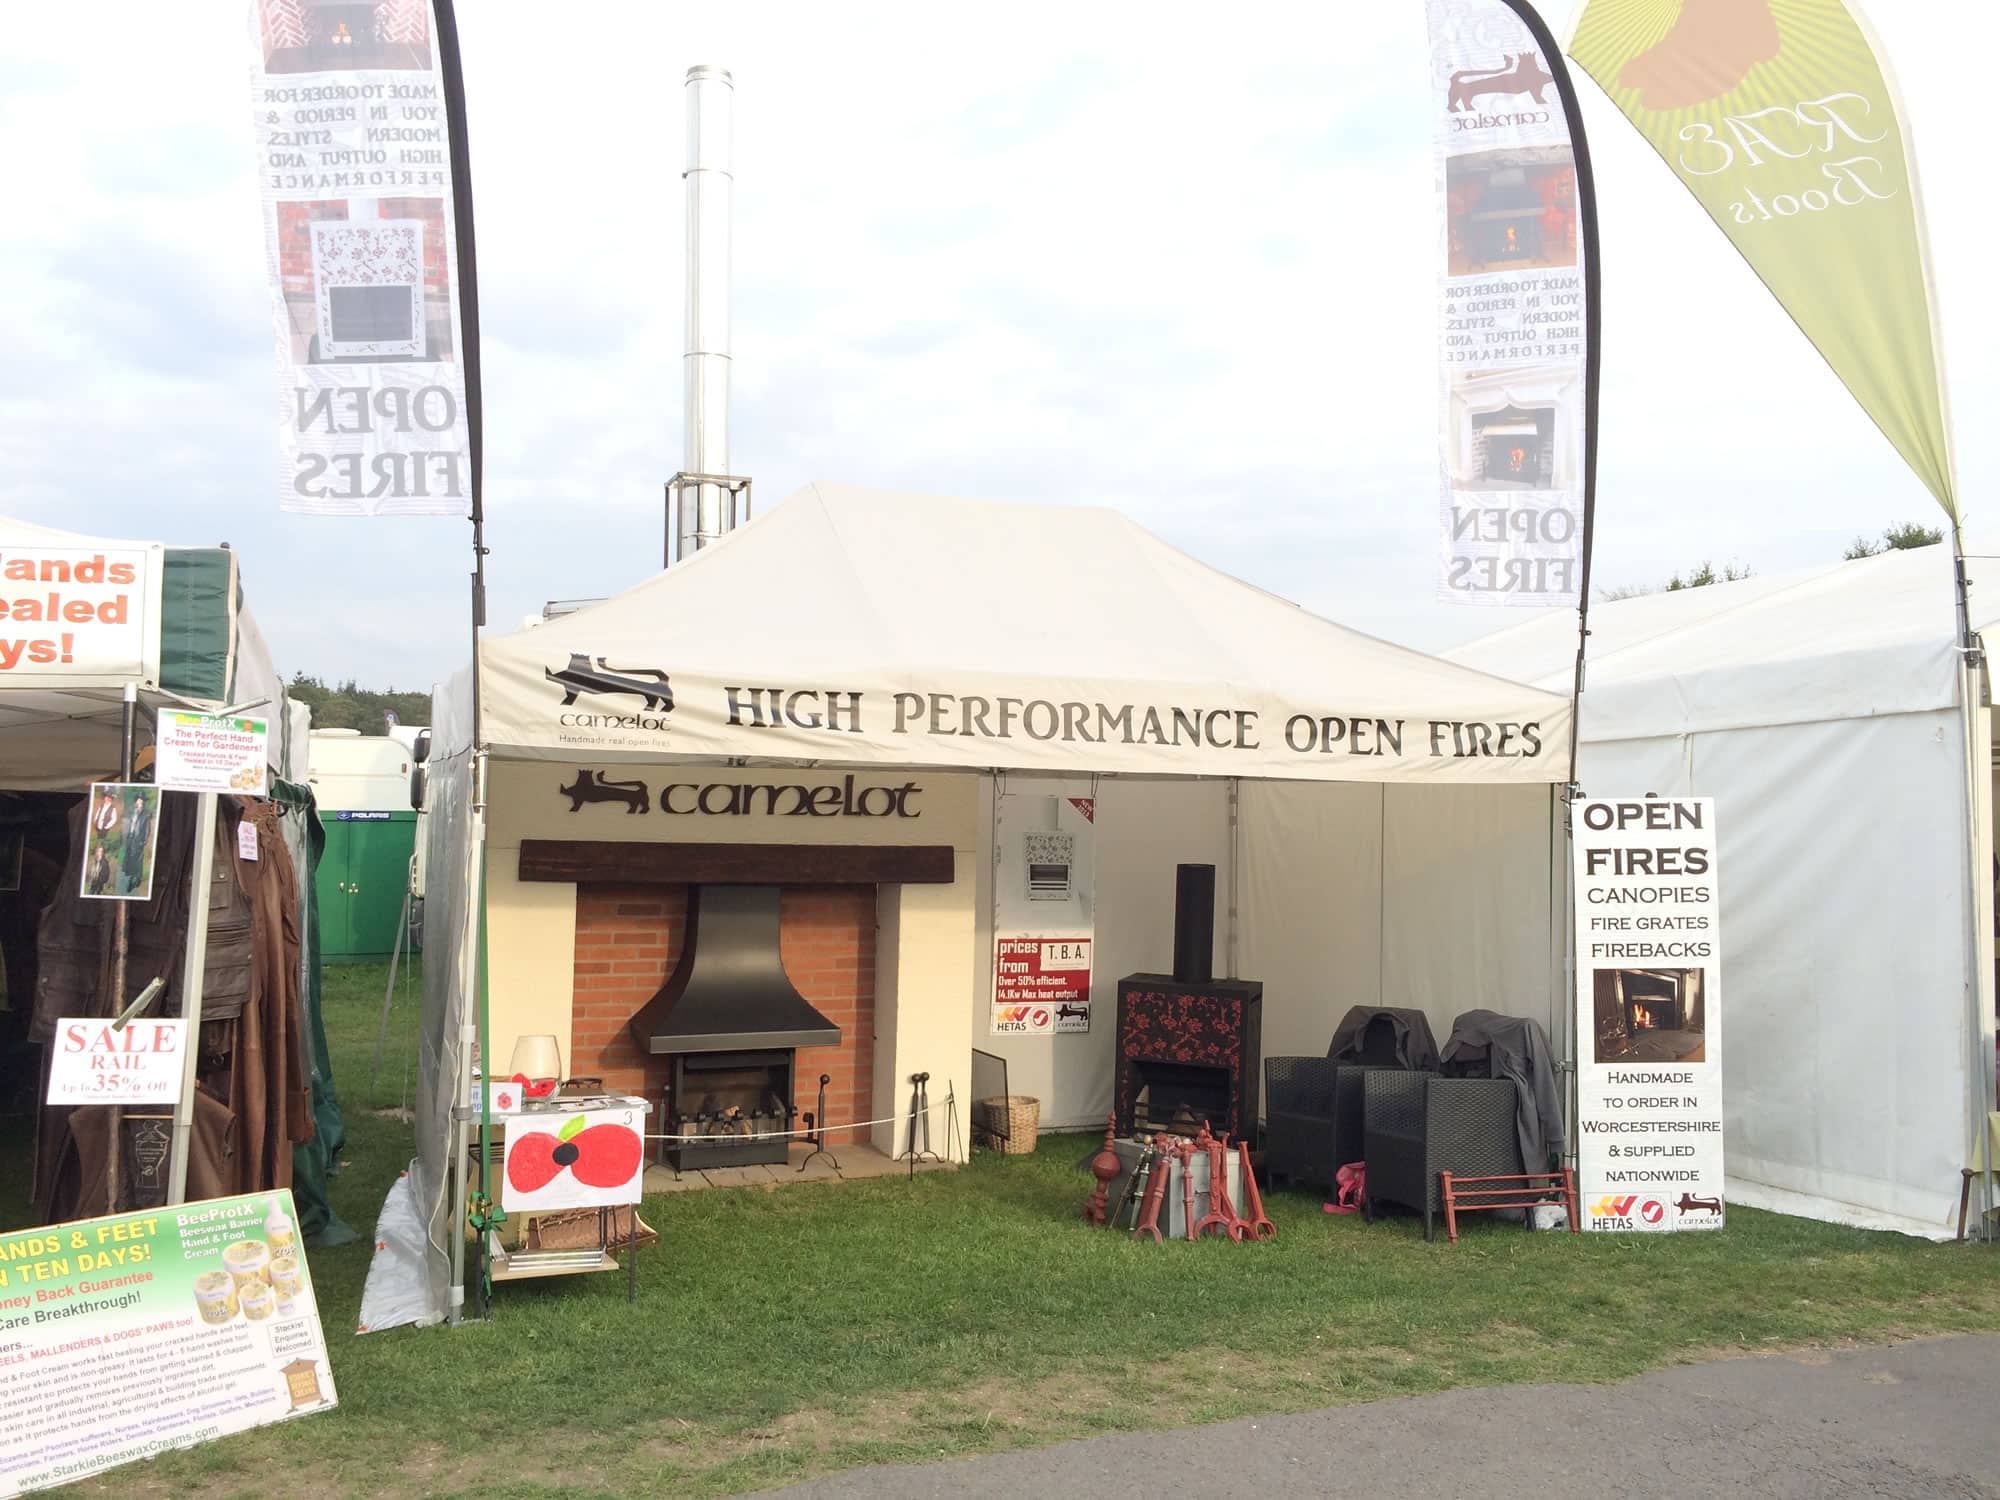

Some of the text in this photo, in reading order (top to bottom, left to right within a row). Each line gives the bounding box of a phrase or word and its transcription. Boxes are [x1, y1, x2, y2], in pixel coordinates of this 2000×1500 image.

[0, 554, 136, 585] ands
[559, 712, 671, 732] camelot
[724, 687, 1542, 758] HIGH PERFORMANCE OPEN FIRES
[164, 737, 194, 746] Cream
[197, 740, 210, 748] for
[176, 729, 253, 743] The Perfect Hand
[559, 734, 605, 746] Handmade
[608, 736, 625, 746] real
[628, 738, 648, 749] open
[660, 774, 923, 818] camelot
[1584, 802, 1703, 831] OPEN
[1586, 847, 1709, 876] FIRES
[1587, 887, 1710, 904] CANOPIES
[1591, 916, 1709, 930] FIRE GRATES
[1000, 940, 1038, 956] prices
[1592, 942, 1711, 958] FIREBACKS
[1000, 958, 1029, 973] from
[998, 976, 1068, 985] Over 50% efficient.
[1022, 989, 1036, 998] Max
[1038, 990, 1053, 998] heat
[1056, 990, 1078, 1000] output
[997, 1023, 1026, 1031] HETAS
[64, 1024, 176, 1053] SALE
[91, 1054, 146, 1070] RAIL
[92, 1074, 140, 1092] 35%
[148, 1081, 167, 1092] Off
[1602, 1097, 1697, 1108] TO ORDER IN
[623, 1111, 633, 1125] 3
[1582, 1121, 1720, 1133] WORCESTERSHIRE
[1608, 1145, 1695, 1157] & SUPPLIED
[1606, 1170, 1700, 1182] NATIONWIDE
[176, 1203, 253, 1226] BeeProtX
[180, 1222, 226, 1236] Beeswax
[1592, 1218, 1633, 1230] HETAS
[69, 1231, 88, 1249] &
[96, 1218, 160, 1244] FEET
[182, 1237, 209, 1247] Hand
[223, 1230, 245, 1240] Foot
[184, 1246, 218, 1259] Cream
[16, 1258, 69, 1282] TEN
[77, 1243, 151, 1271] DAYS!
[35, 1284, 73, 1301] Back
[78, 1269, 152, 1293] Guarantee
[35, 1291, 141, 1324] Breakthrough!
[31, 1337, 101, 1358] MALLENDERS
[146, 1321, 174, 1333] PAWS
[20, 1370, 39, 1378] Foot
[42, 1363, 68, 1373] Cream
[72, 1357, 95, 1367] works
[18, 1424, 217, 1486] www.StarkieBeeswaxCreams.com
